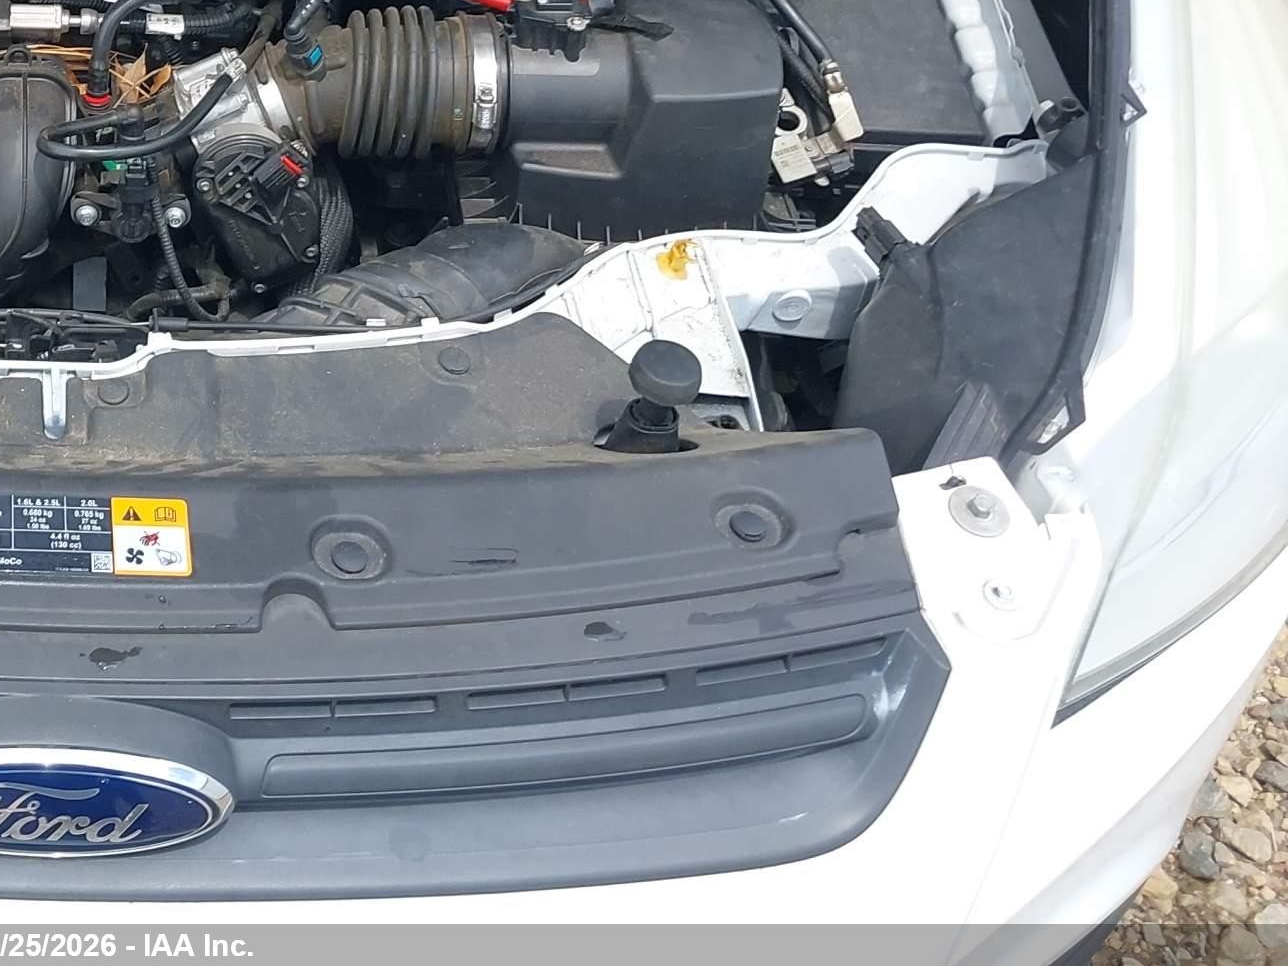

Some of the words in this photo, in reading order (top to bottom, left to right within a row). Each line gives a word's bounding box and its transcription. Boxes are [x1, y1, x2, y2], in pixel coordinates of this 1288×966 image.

[43, 509, 53, 518] kg
[94, 511, 105, 519] kg
[68, 541, 82, 550] cc)
